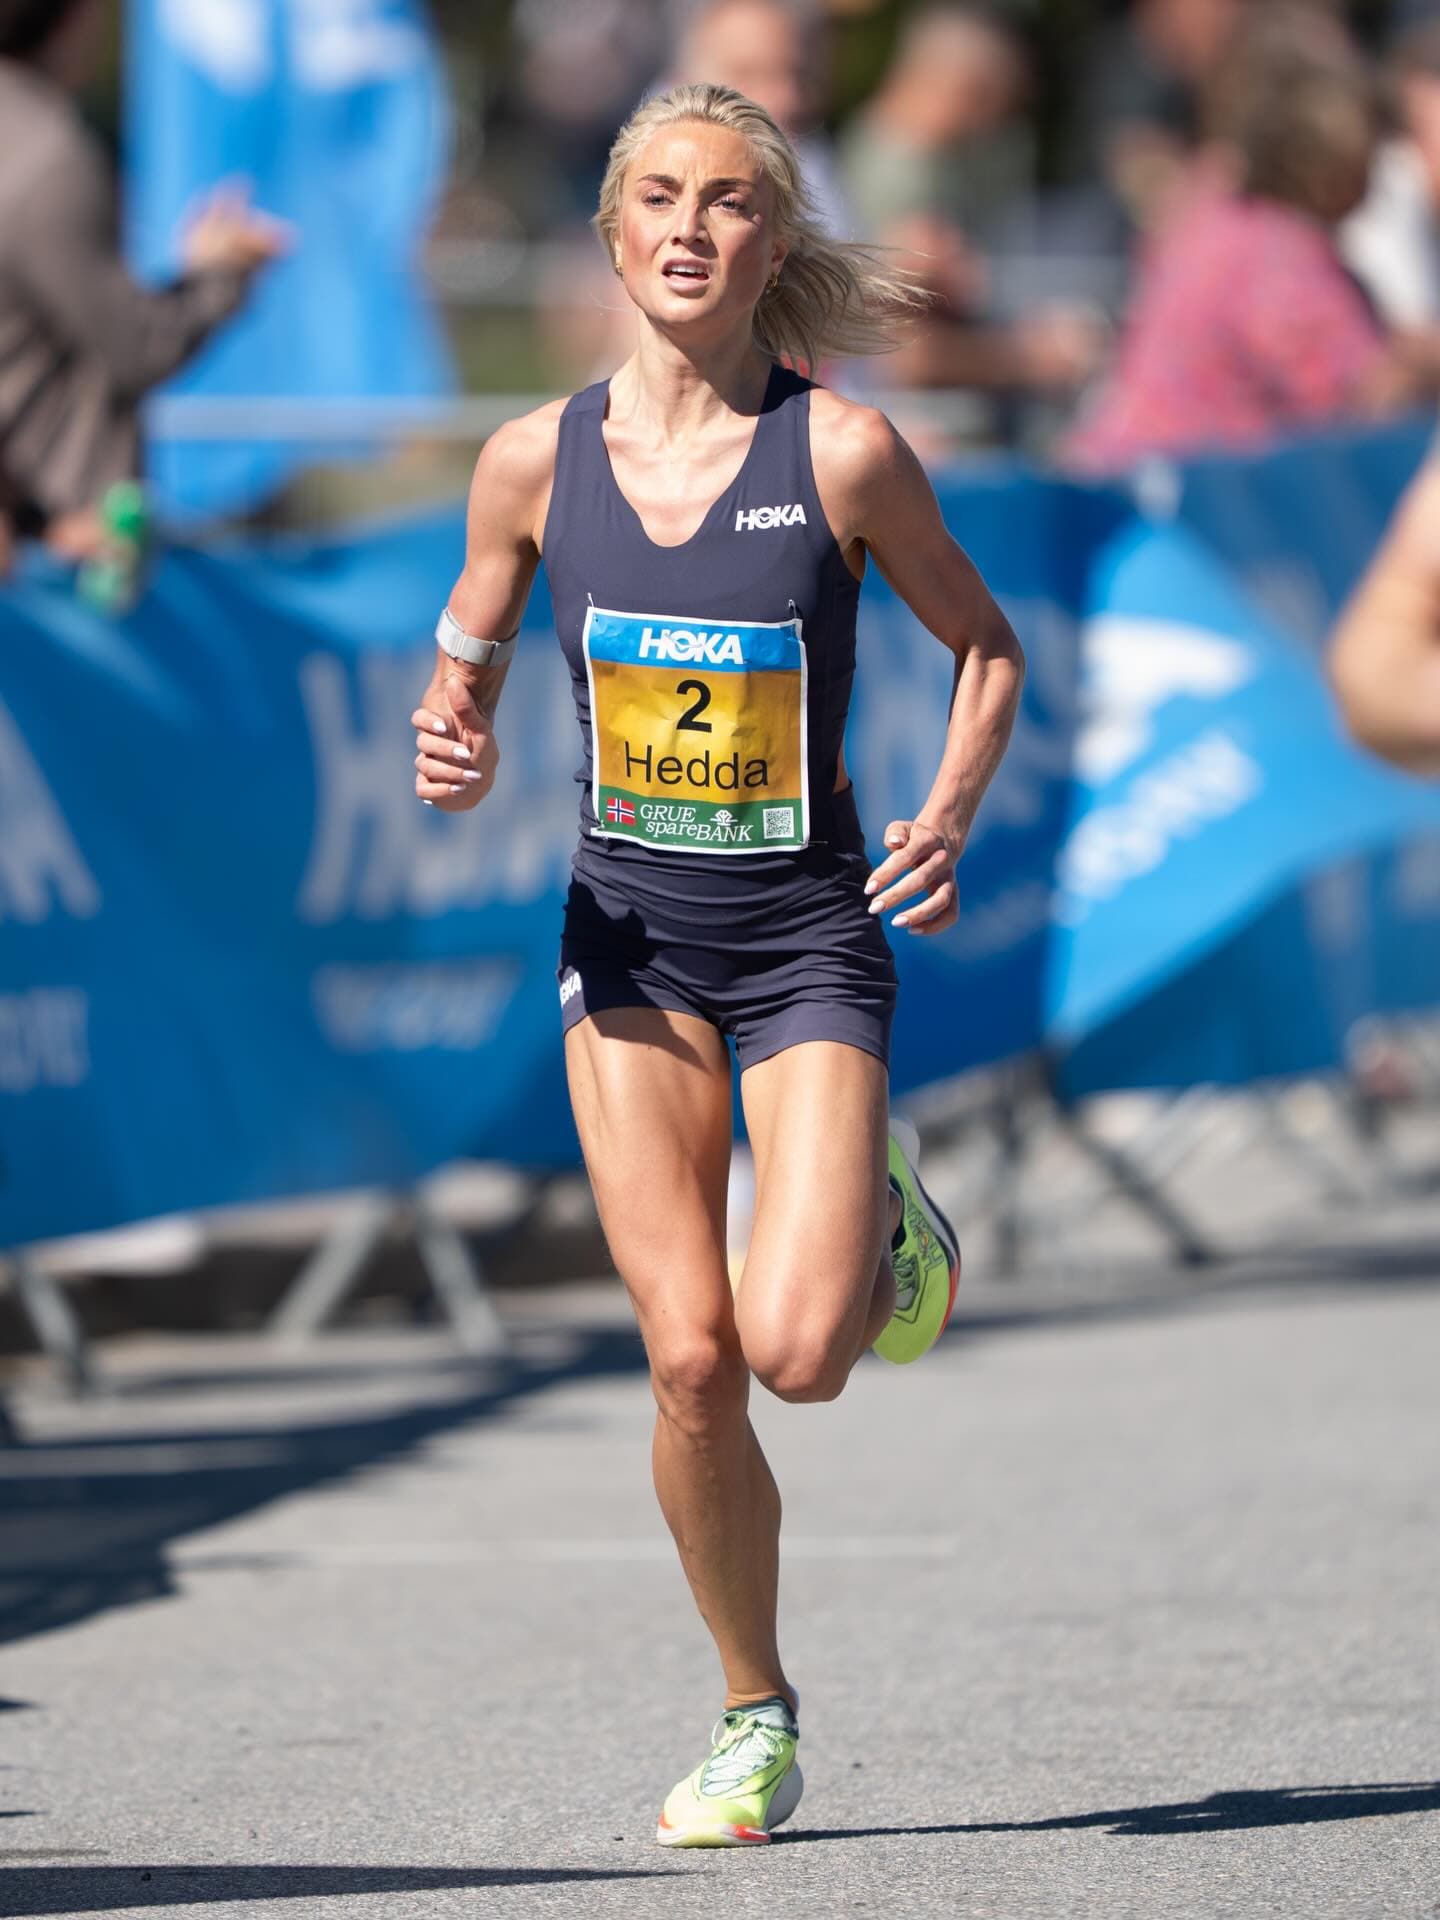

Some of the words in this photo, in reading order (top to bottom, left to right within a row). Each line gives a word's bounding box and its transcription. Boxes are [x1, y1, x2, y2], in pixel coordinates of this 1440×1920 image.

[735, 504, 807, 532] HOKA
[638, 627, 744, 665] HOKA
[676, 679, 713, 733] 2
[624, 740, 769, 790] Hedda
[640, 803, 697, 823] GRUE
[645, 820, 755, 842] spareBANK
[559, 971, 582, 1008] OKA
